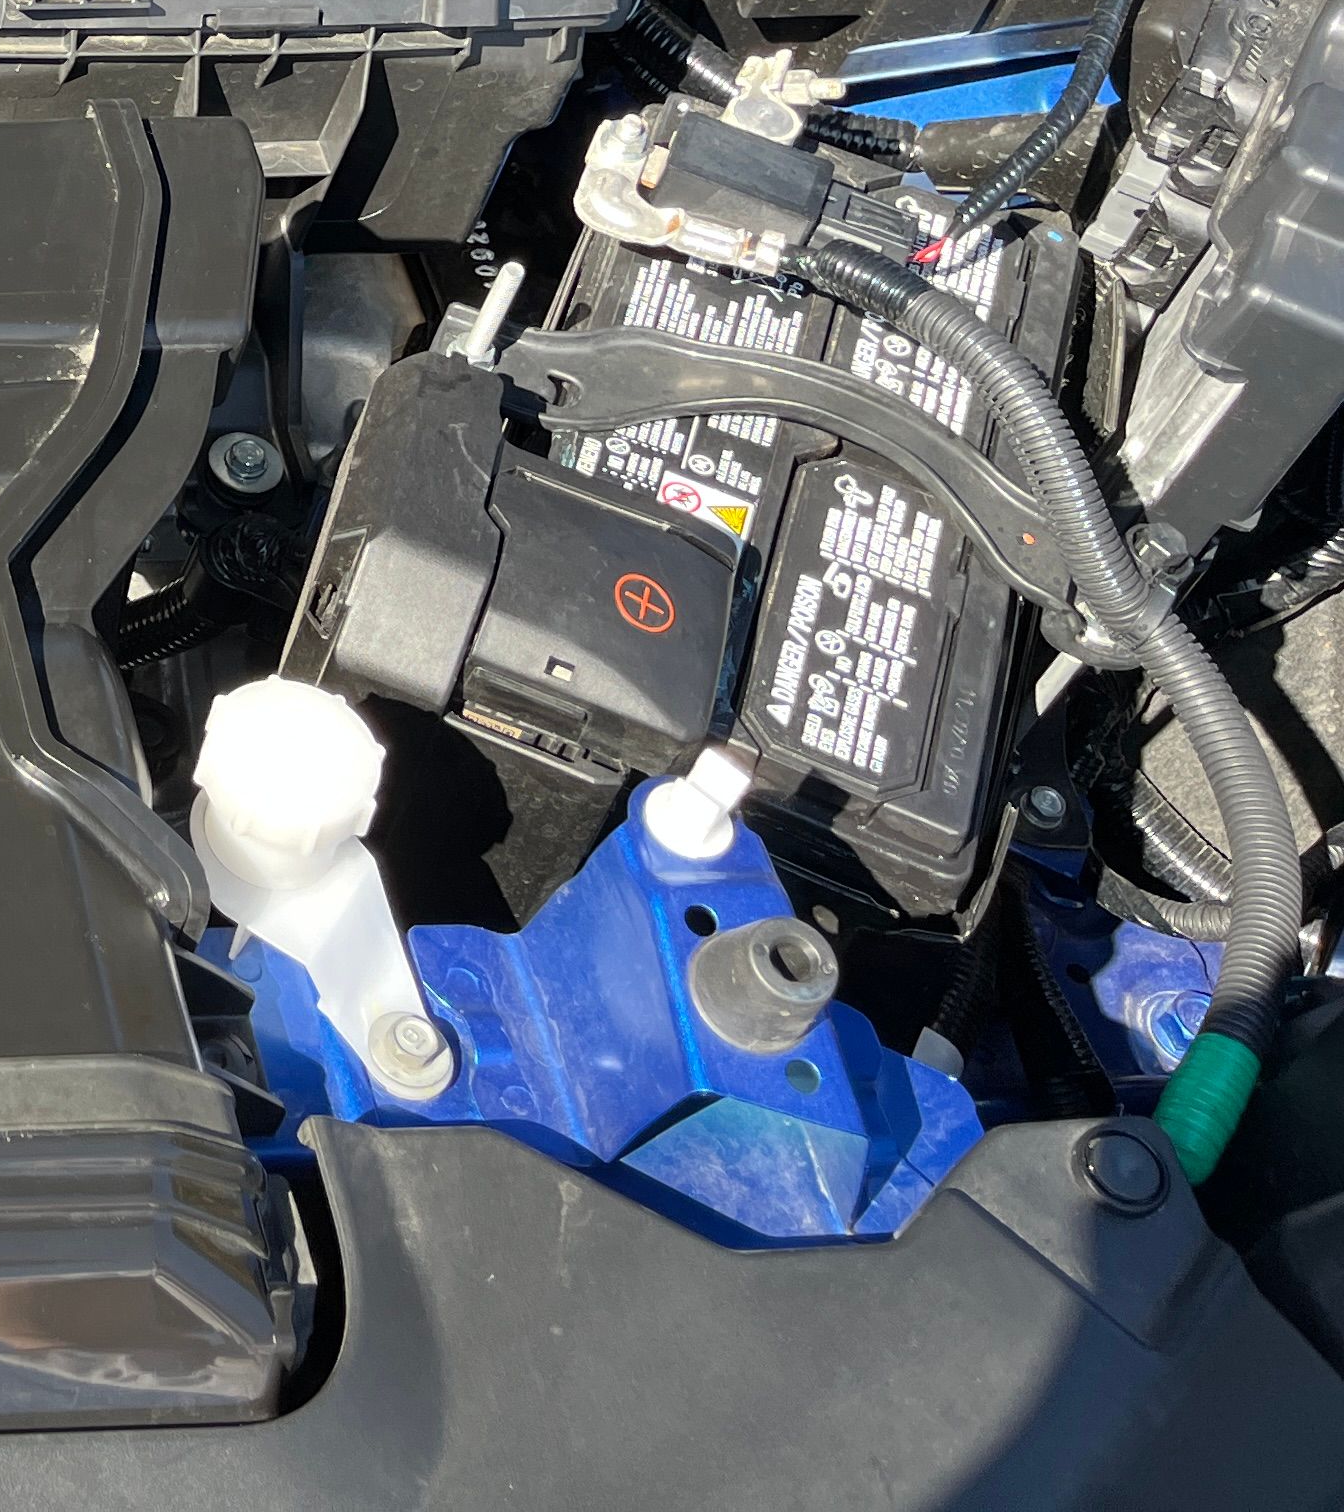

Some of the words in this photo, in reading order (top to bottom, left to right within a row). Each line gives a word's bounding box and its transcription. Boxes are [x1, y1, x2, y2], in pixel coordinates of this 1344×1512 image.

[769, 573, 824, 703] DANGER/POISON
[843, 684, 864, 717] GASES
[800, 712, 822, 748] SHIELD
[816, 726, 836, 754] EYES
[833, 712, 858, 761] EXPLOSIVE
